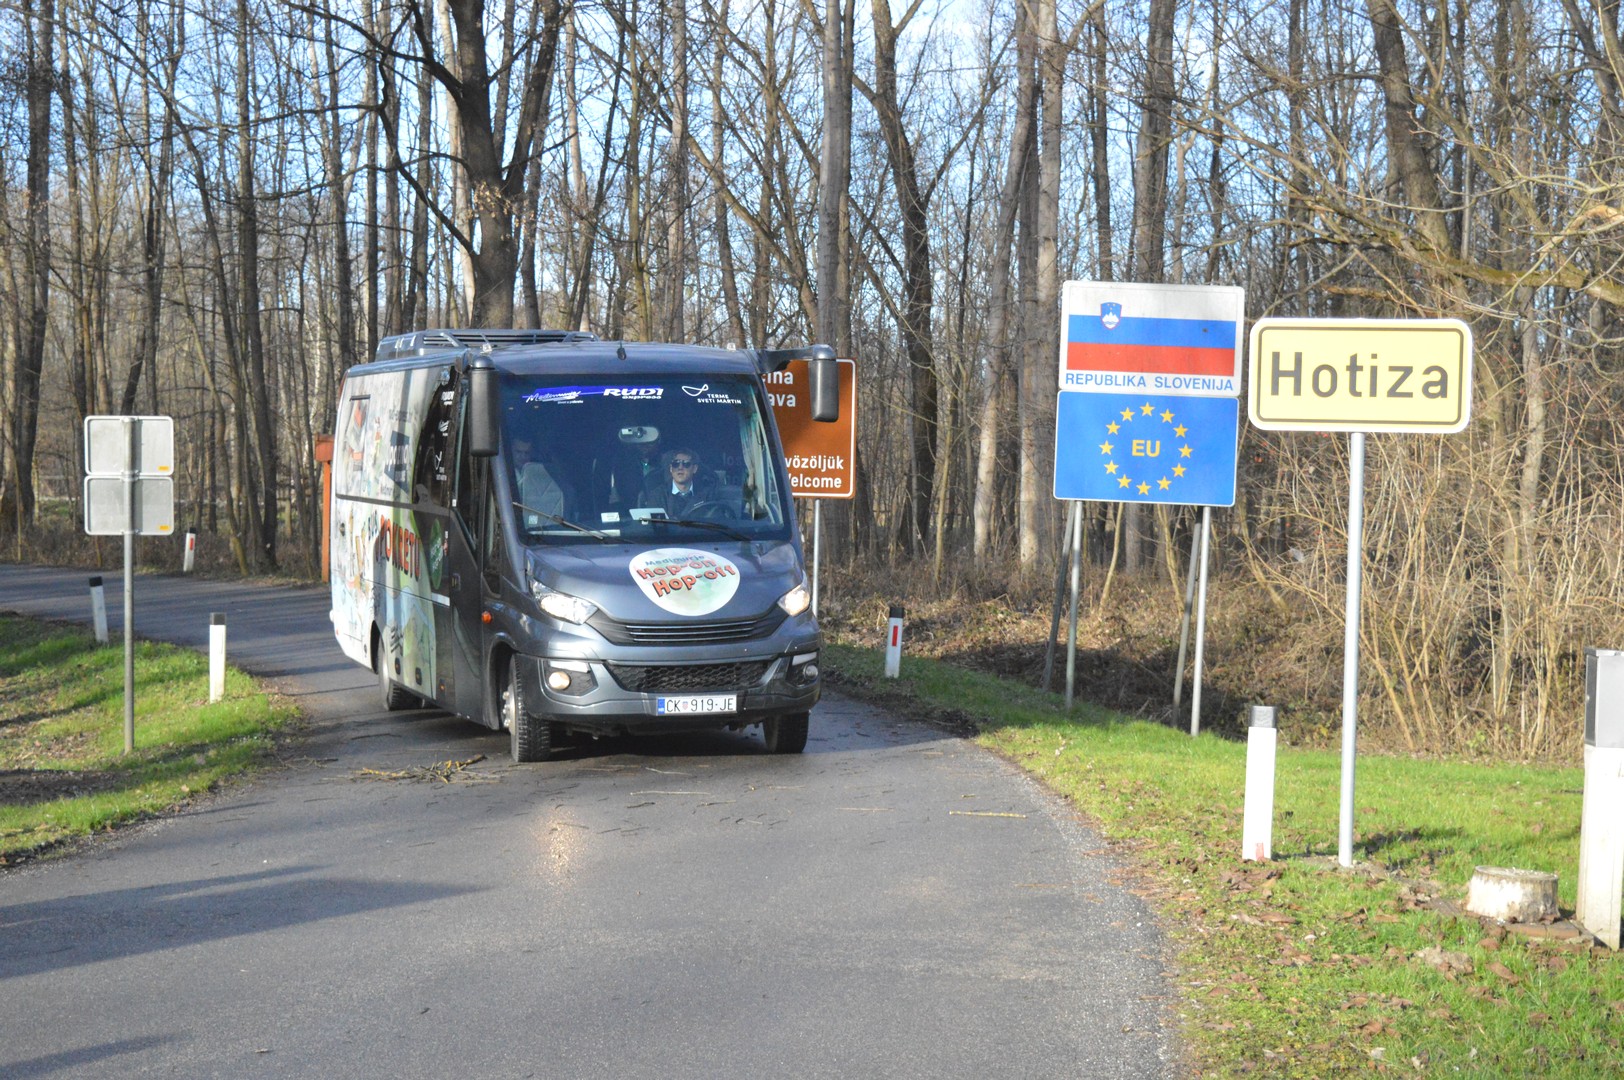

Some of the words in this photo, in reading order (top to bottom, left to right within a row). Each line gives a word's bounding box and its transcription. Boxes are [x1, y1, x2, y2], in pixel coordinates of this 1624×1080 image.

[1065, 373, 1147, 388] REPUBLIKA
[1154, 376, 1234, 391] SLOVENIJA
[1270, 351, 1448, 399] Hotiza
[603, 388, 664, 396] RUDI
[1132, 439, 1160, 457] EU
[788, 473, 842, 488] elcome
[636, 560, 717, 579] Hop-on
[652, 565, 736, 597] Hop-off
[666, 699, 681, 713] CK
